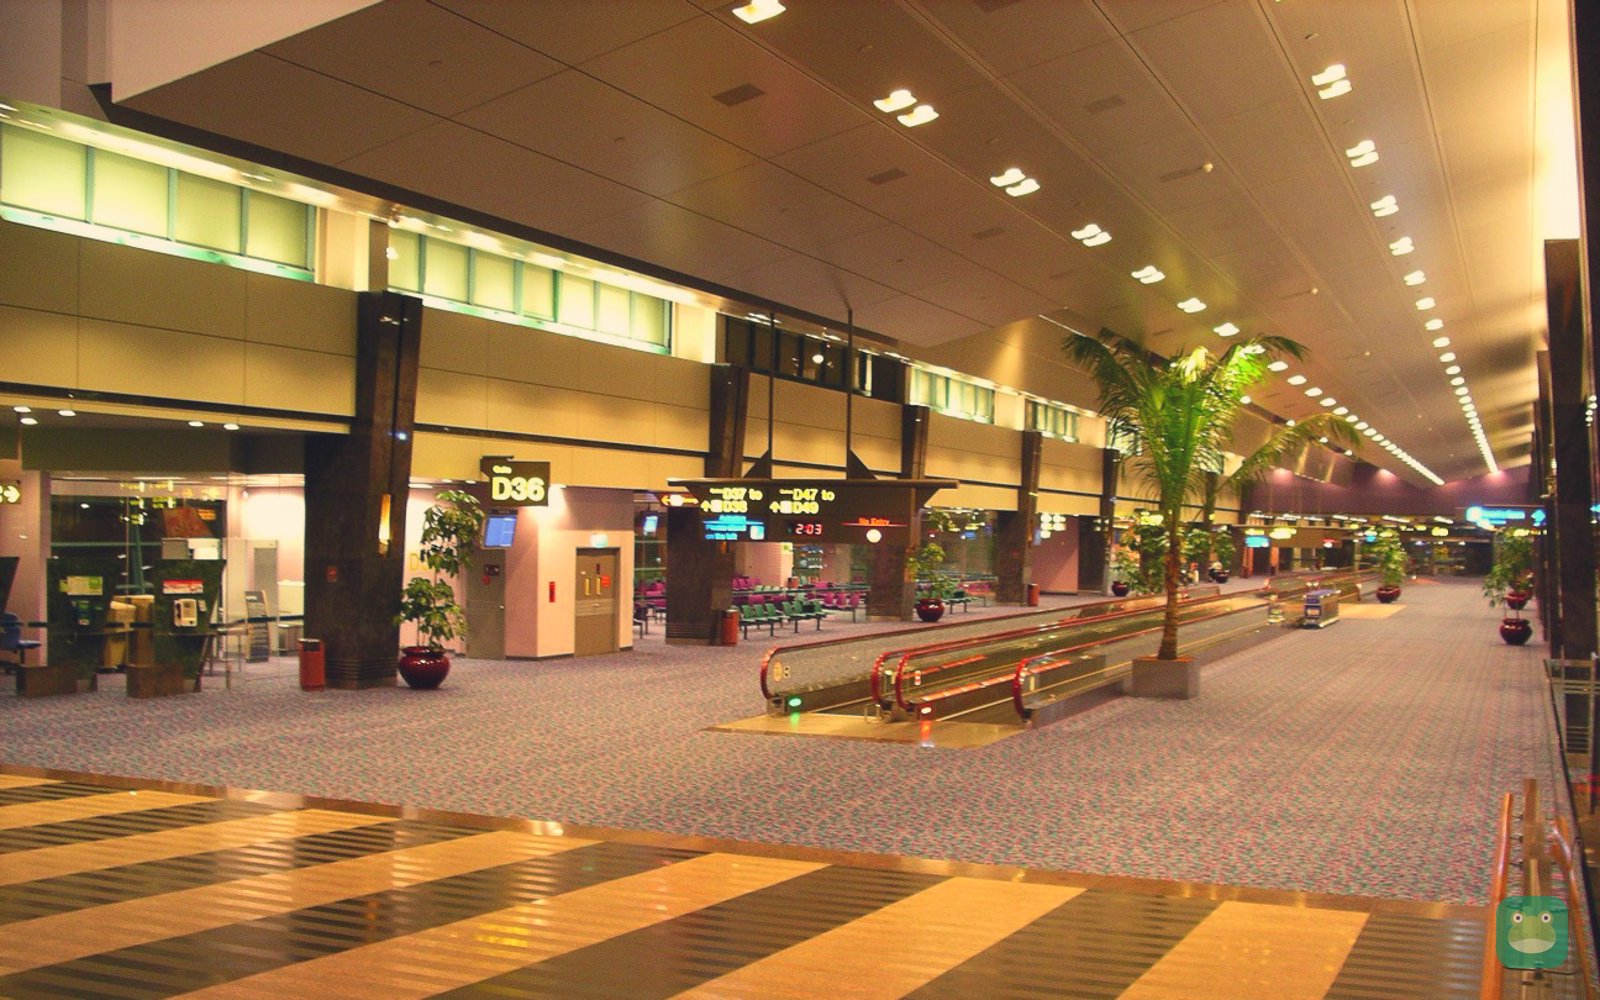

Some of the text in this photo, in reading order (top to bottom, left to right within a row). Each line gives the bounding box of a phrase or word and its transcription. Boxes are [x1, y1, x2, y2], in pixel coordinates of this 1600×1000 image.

[492, 477, 545, 501] D36
[748, 488, 764, 501] to
[792, 488, 818, 501] D47
[821, 489, 836, 501] to
